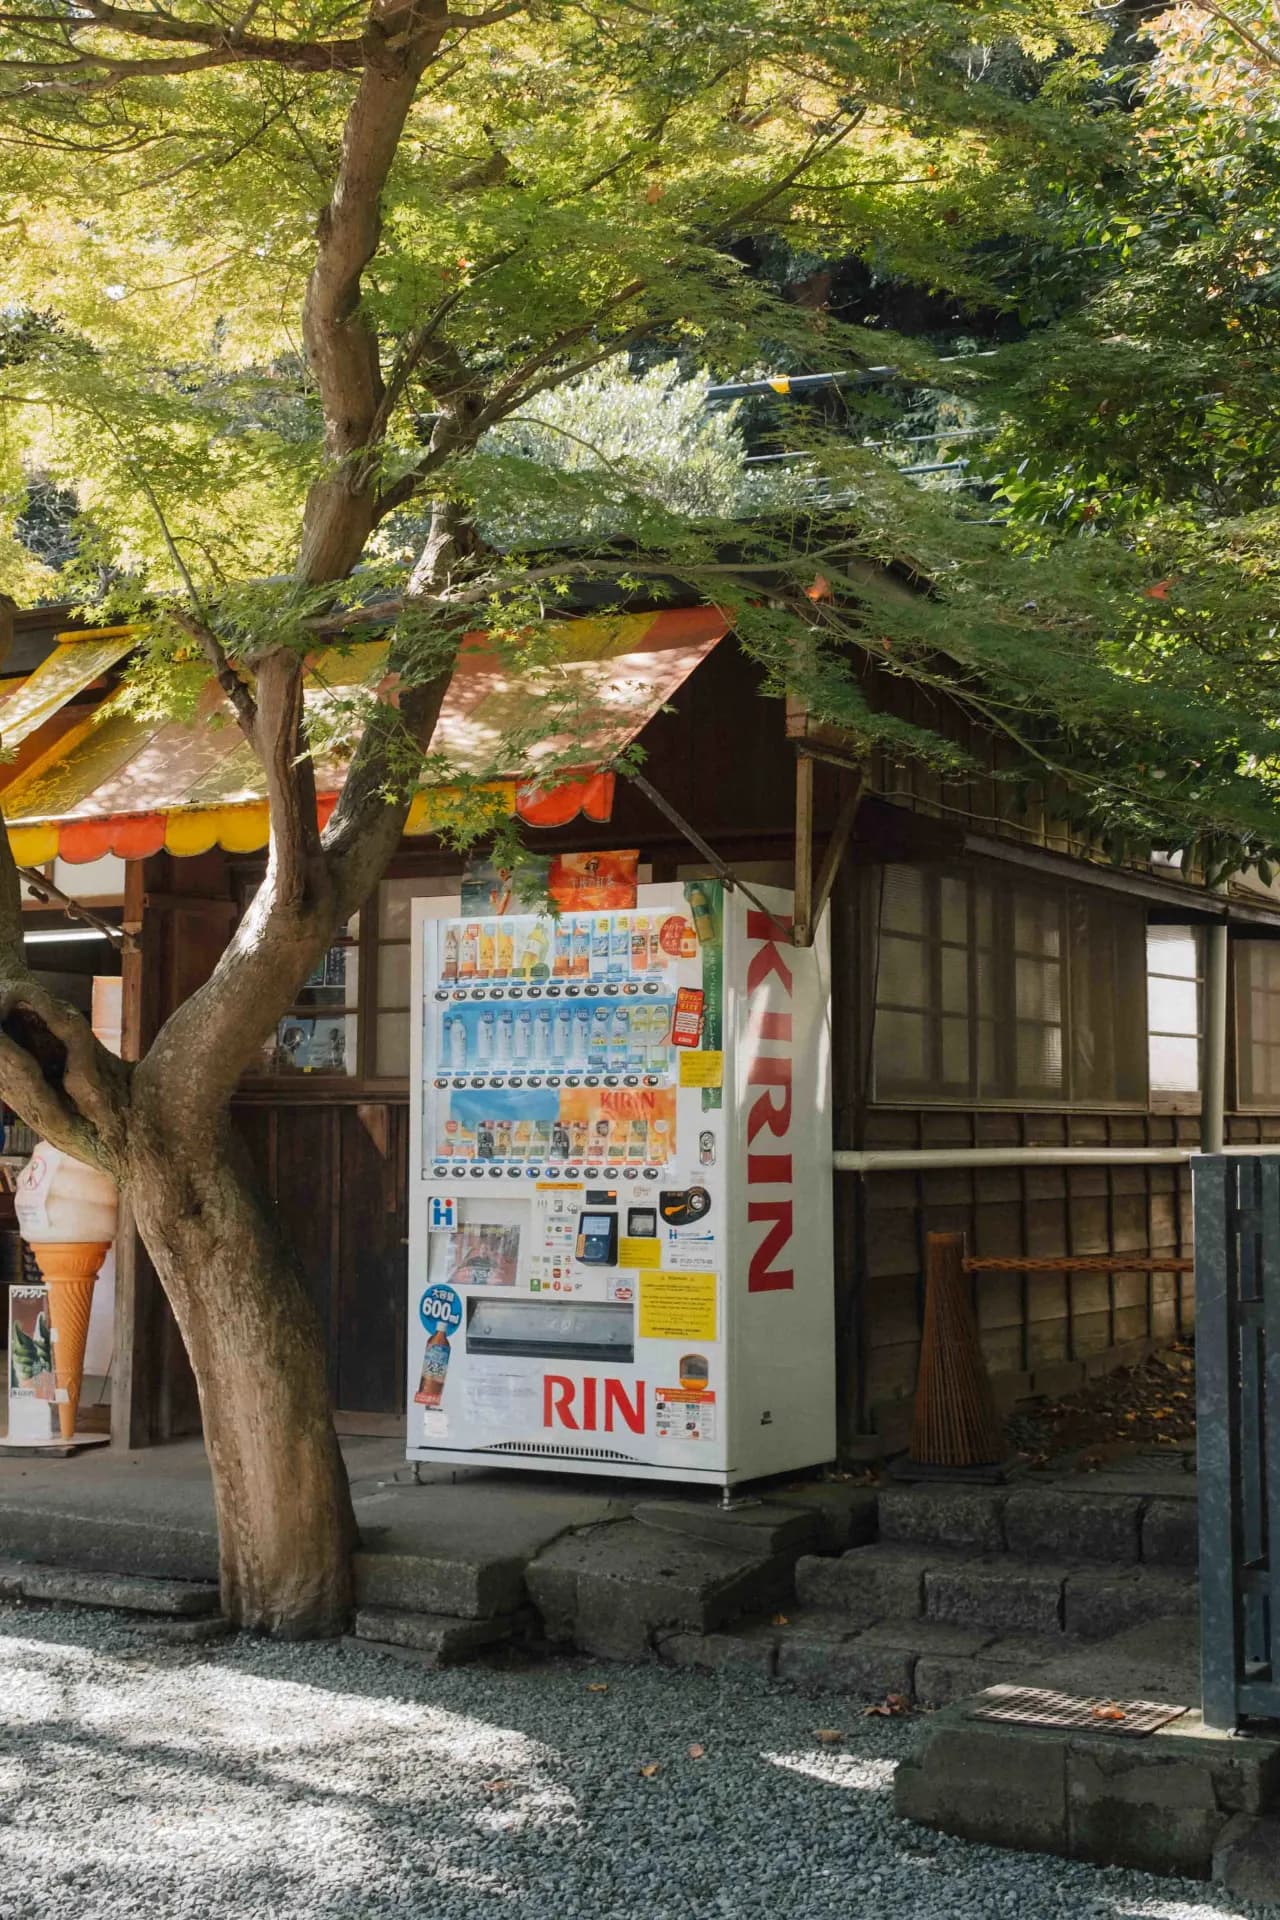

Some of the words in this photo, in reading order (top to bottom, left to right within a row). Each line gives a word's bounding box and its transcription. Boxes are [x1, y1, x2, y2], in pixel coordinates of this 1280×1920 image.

[600, 1092, 655, 1110] KIRIN
[746, 909, 794, 1293] KIRIN
[543, 1375, 645, 1435] RIN
